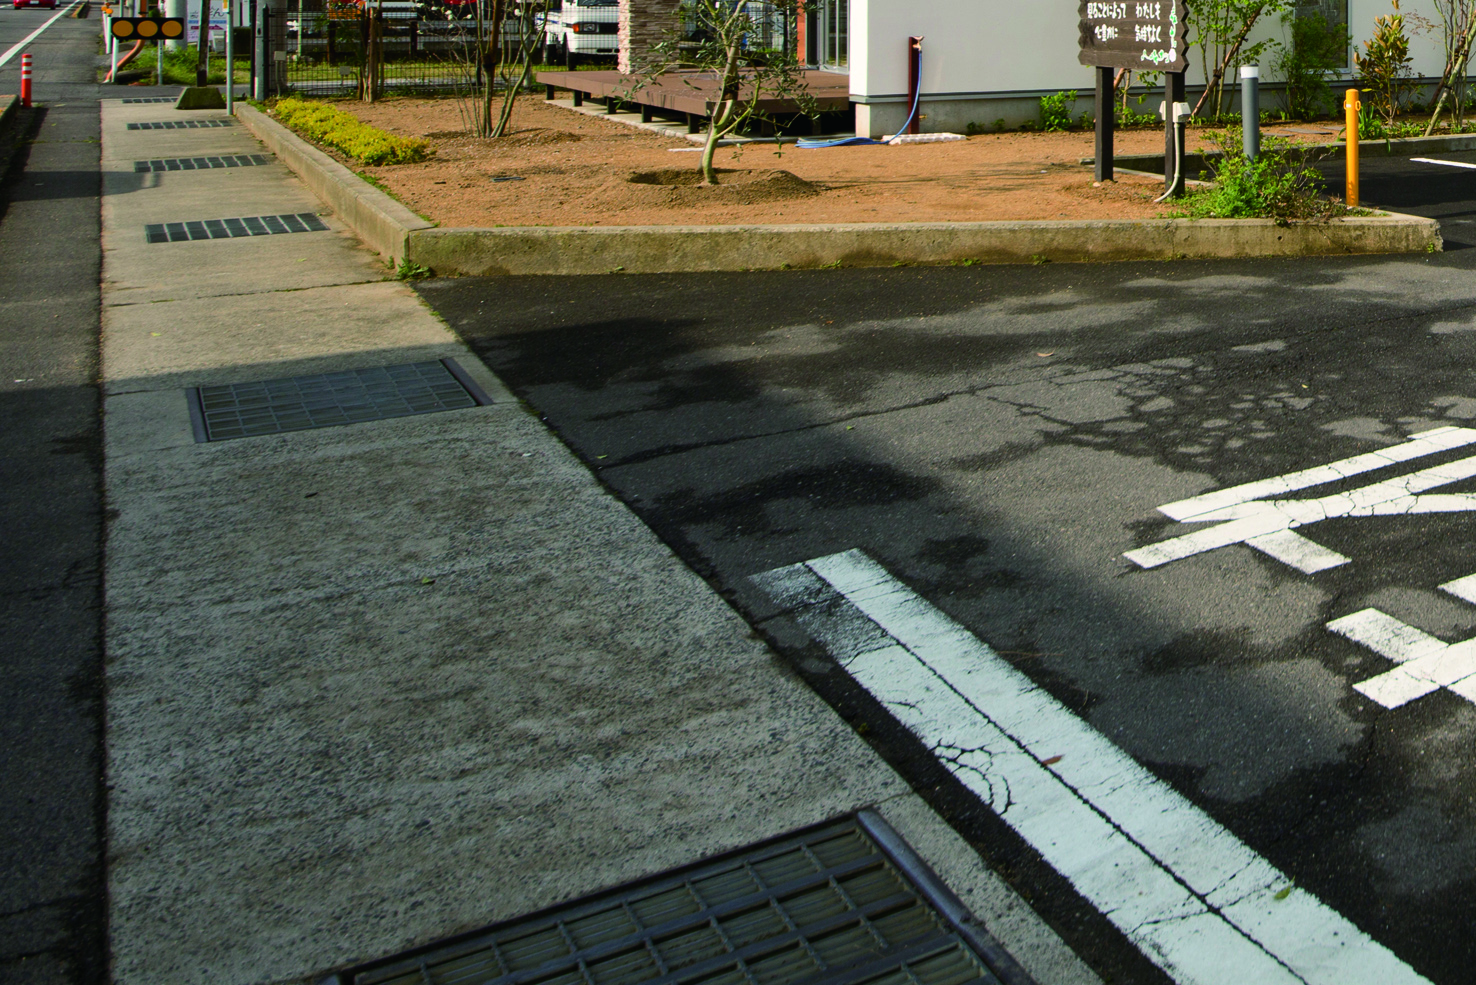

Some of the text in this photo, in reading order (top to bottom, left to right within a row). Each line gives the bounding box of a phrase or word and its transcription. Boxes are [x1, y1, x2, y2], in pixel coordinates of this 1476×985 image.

[1087, 2, 1161, 20] 見ることによって わたしを
